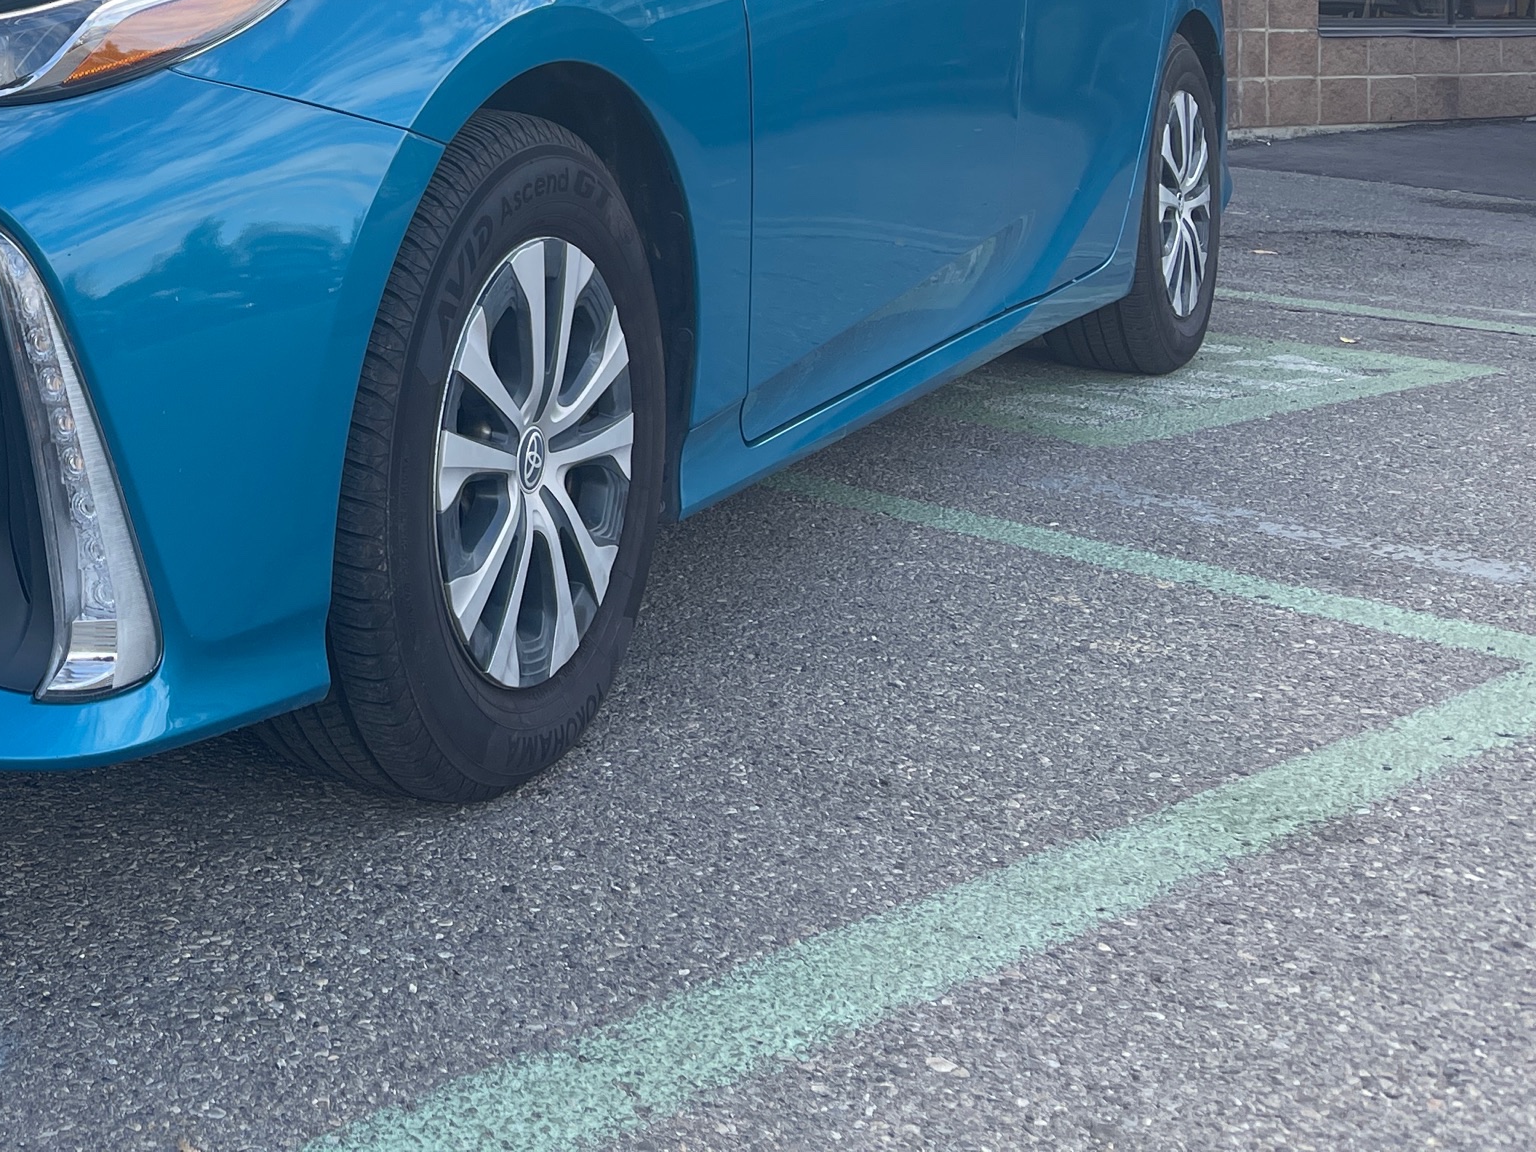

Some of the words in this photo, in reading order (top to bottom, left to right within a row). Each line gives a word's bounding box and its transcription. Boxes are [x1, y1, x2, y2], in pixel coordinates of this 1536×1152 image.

[438, 215, 494, 355] AVID
[500, 168, 569, 226] Ascend
[574, 169, 614, 212] GT
